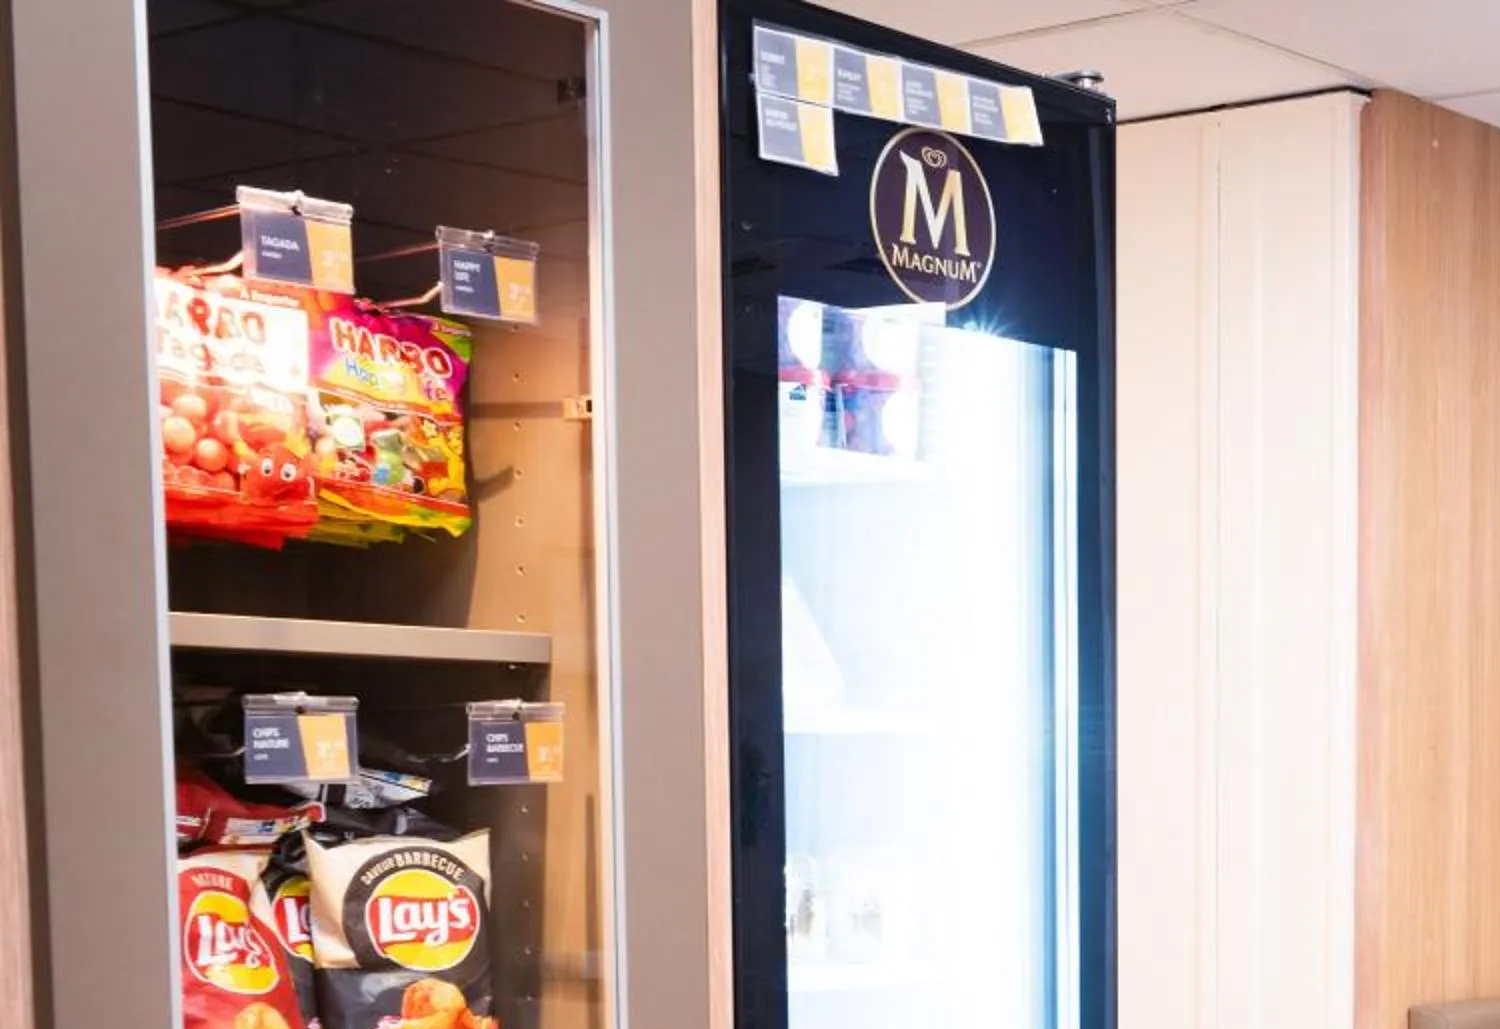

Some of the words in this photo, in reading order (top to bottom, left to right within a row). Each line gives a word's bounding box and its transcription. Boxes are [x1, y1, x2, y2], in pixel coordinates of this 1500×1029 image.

[891, 243, 978, 284] MAGNUM
[394, 850, 465, 881] BARBECUE
[378, 889, 473, 948] Lay's
